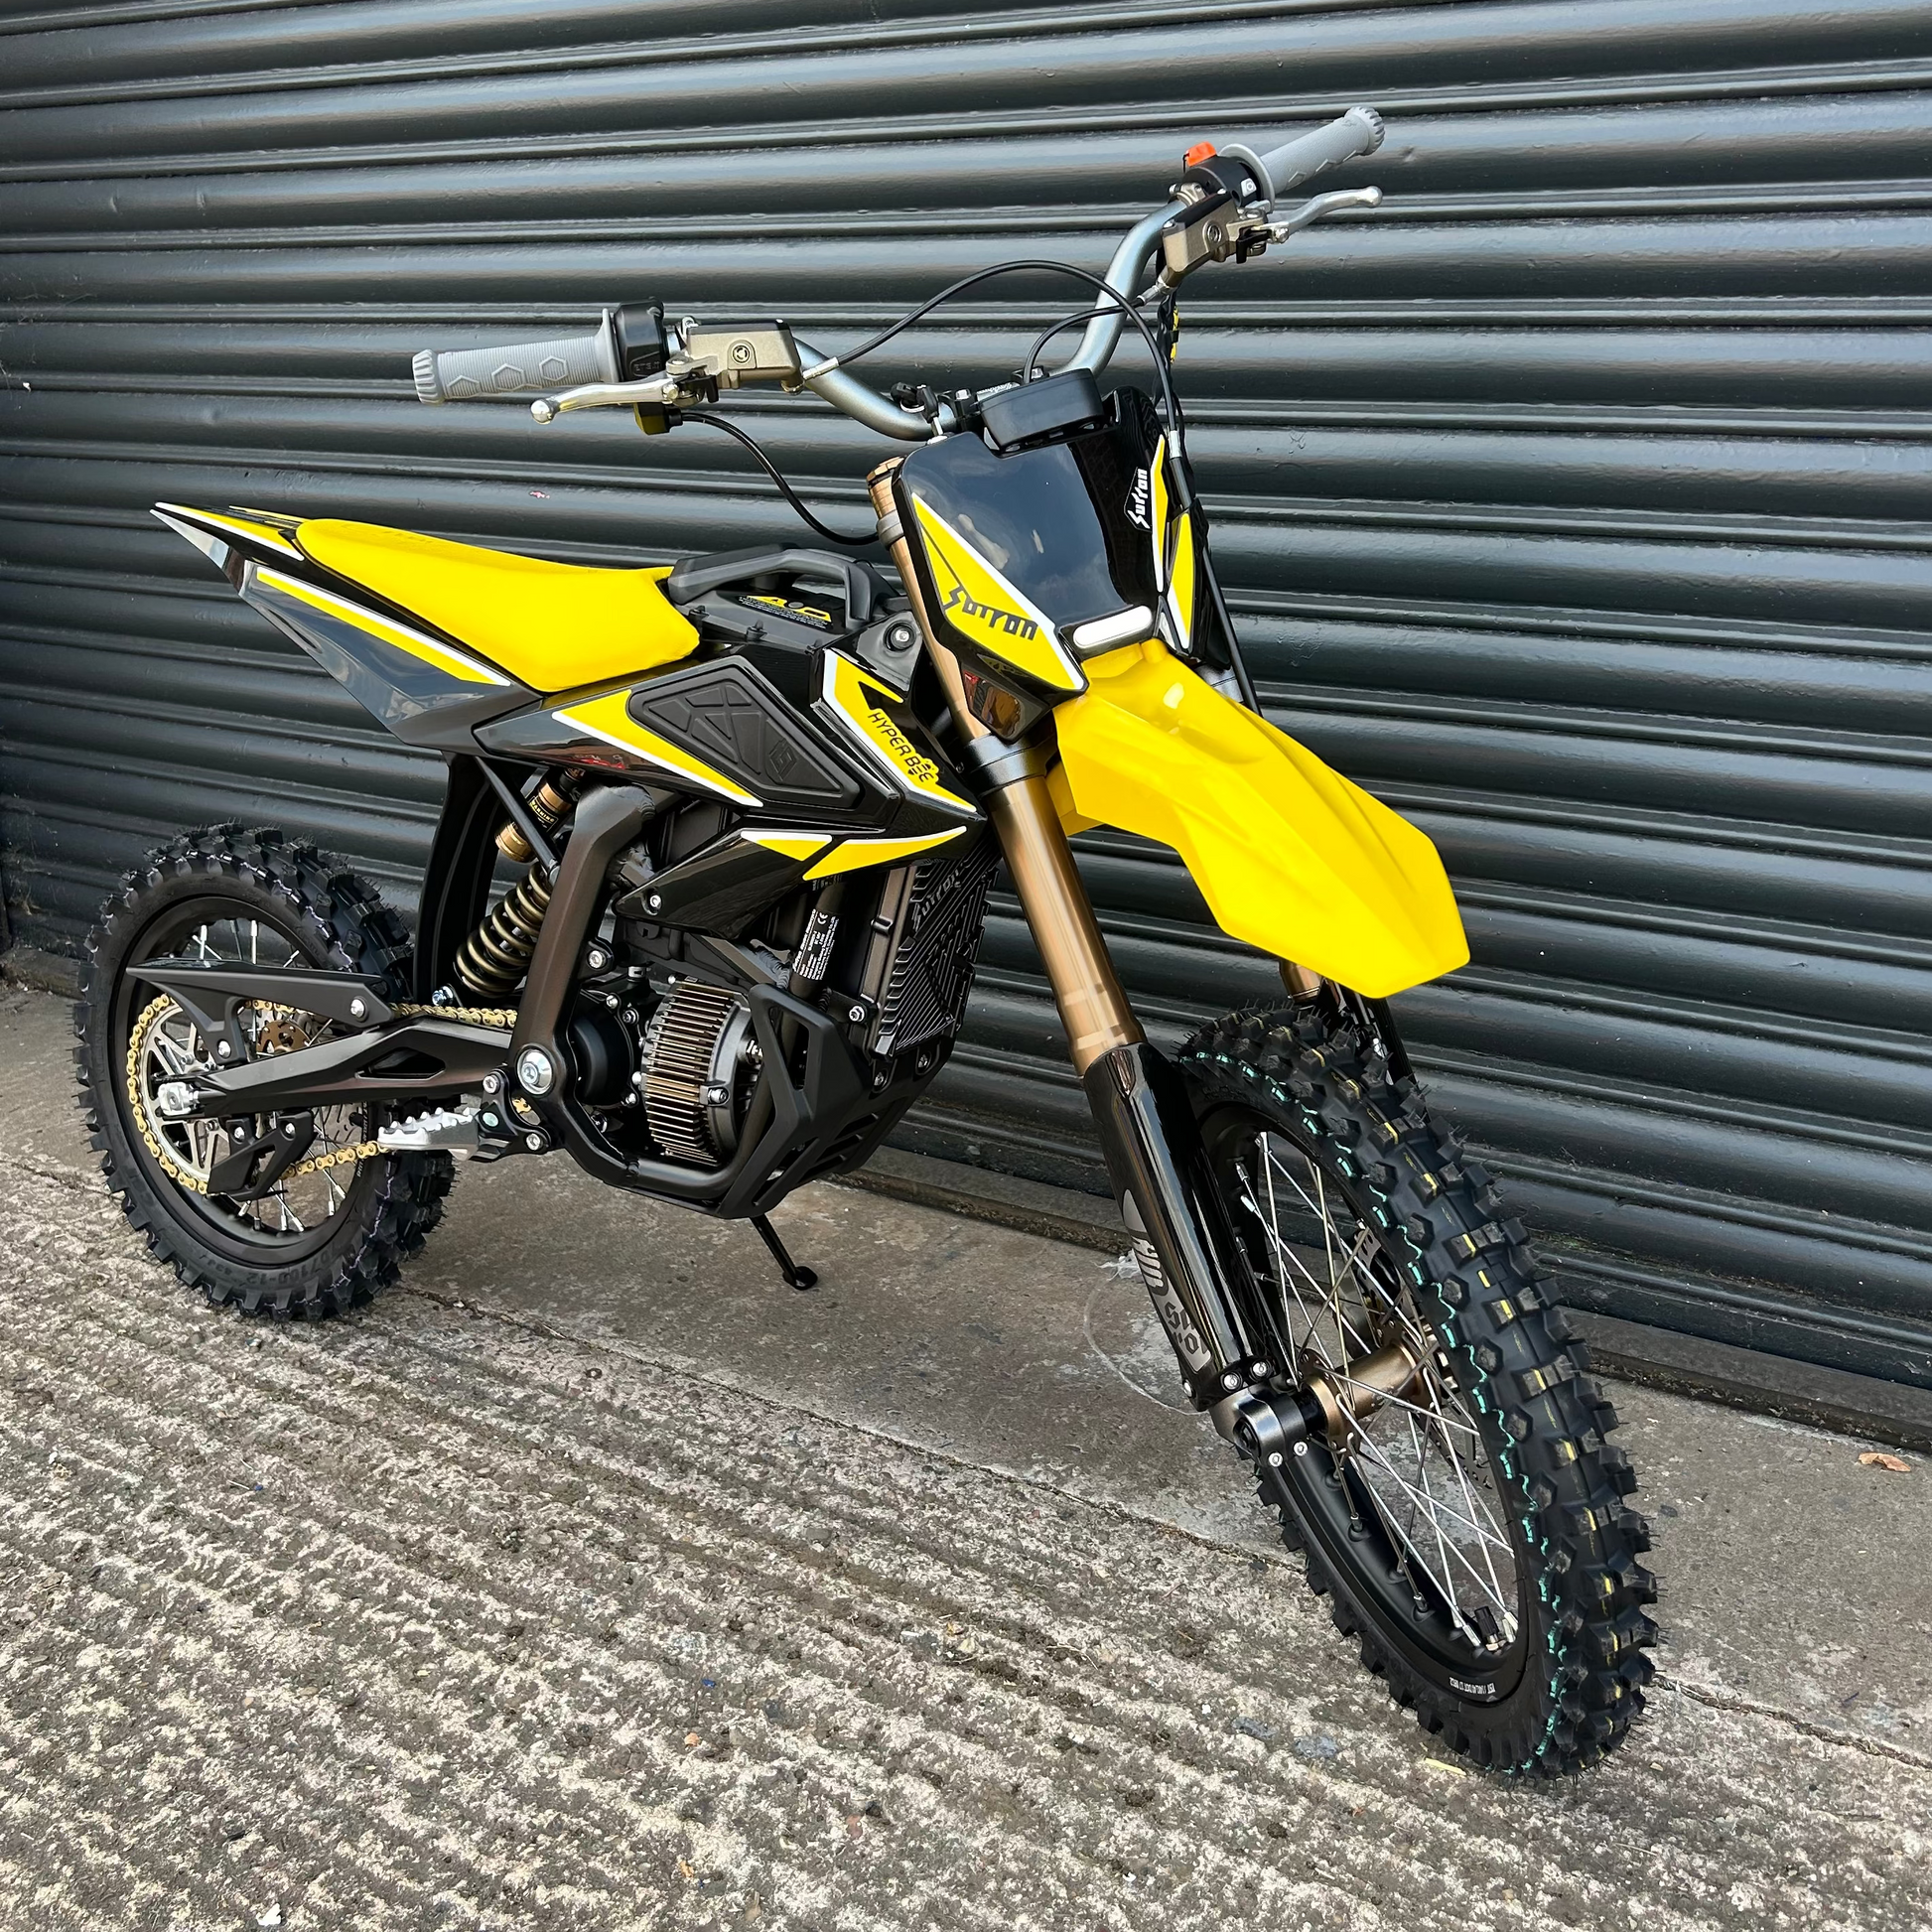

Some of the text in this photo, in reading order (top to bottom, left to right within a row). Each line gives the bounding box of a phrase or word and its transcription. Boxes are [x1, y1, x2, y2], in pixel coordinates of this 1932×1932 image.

[1127, 468, 1151, 529] Surron
[943, 585, 1038, 641] Surron
[868, 712, 935, 782] HYPER BEE
